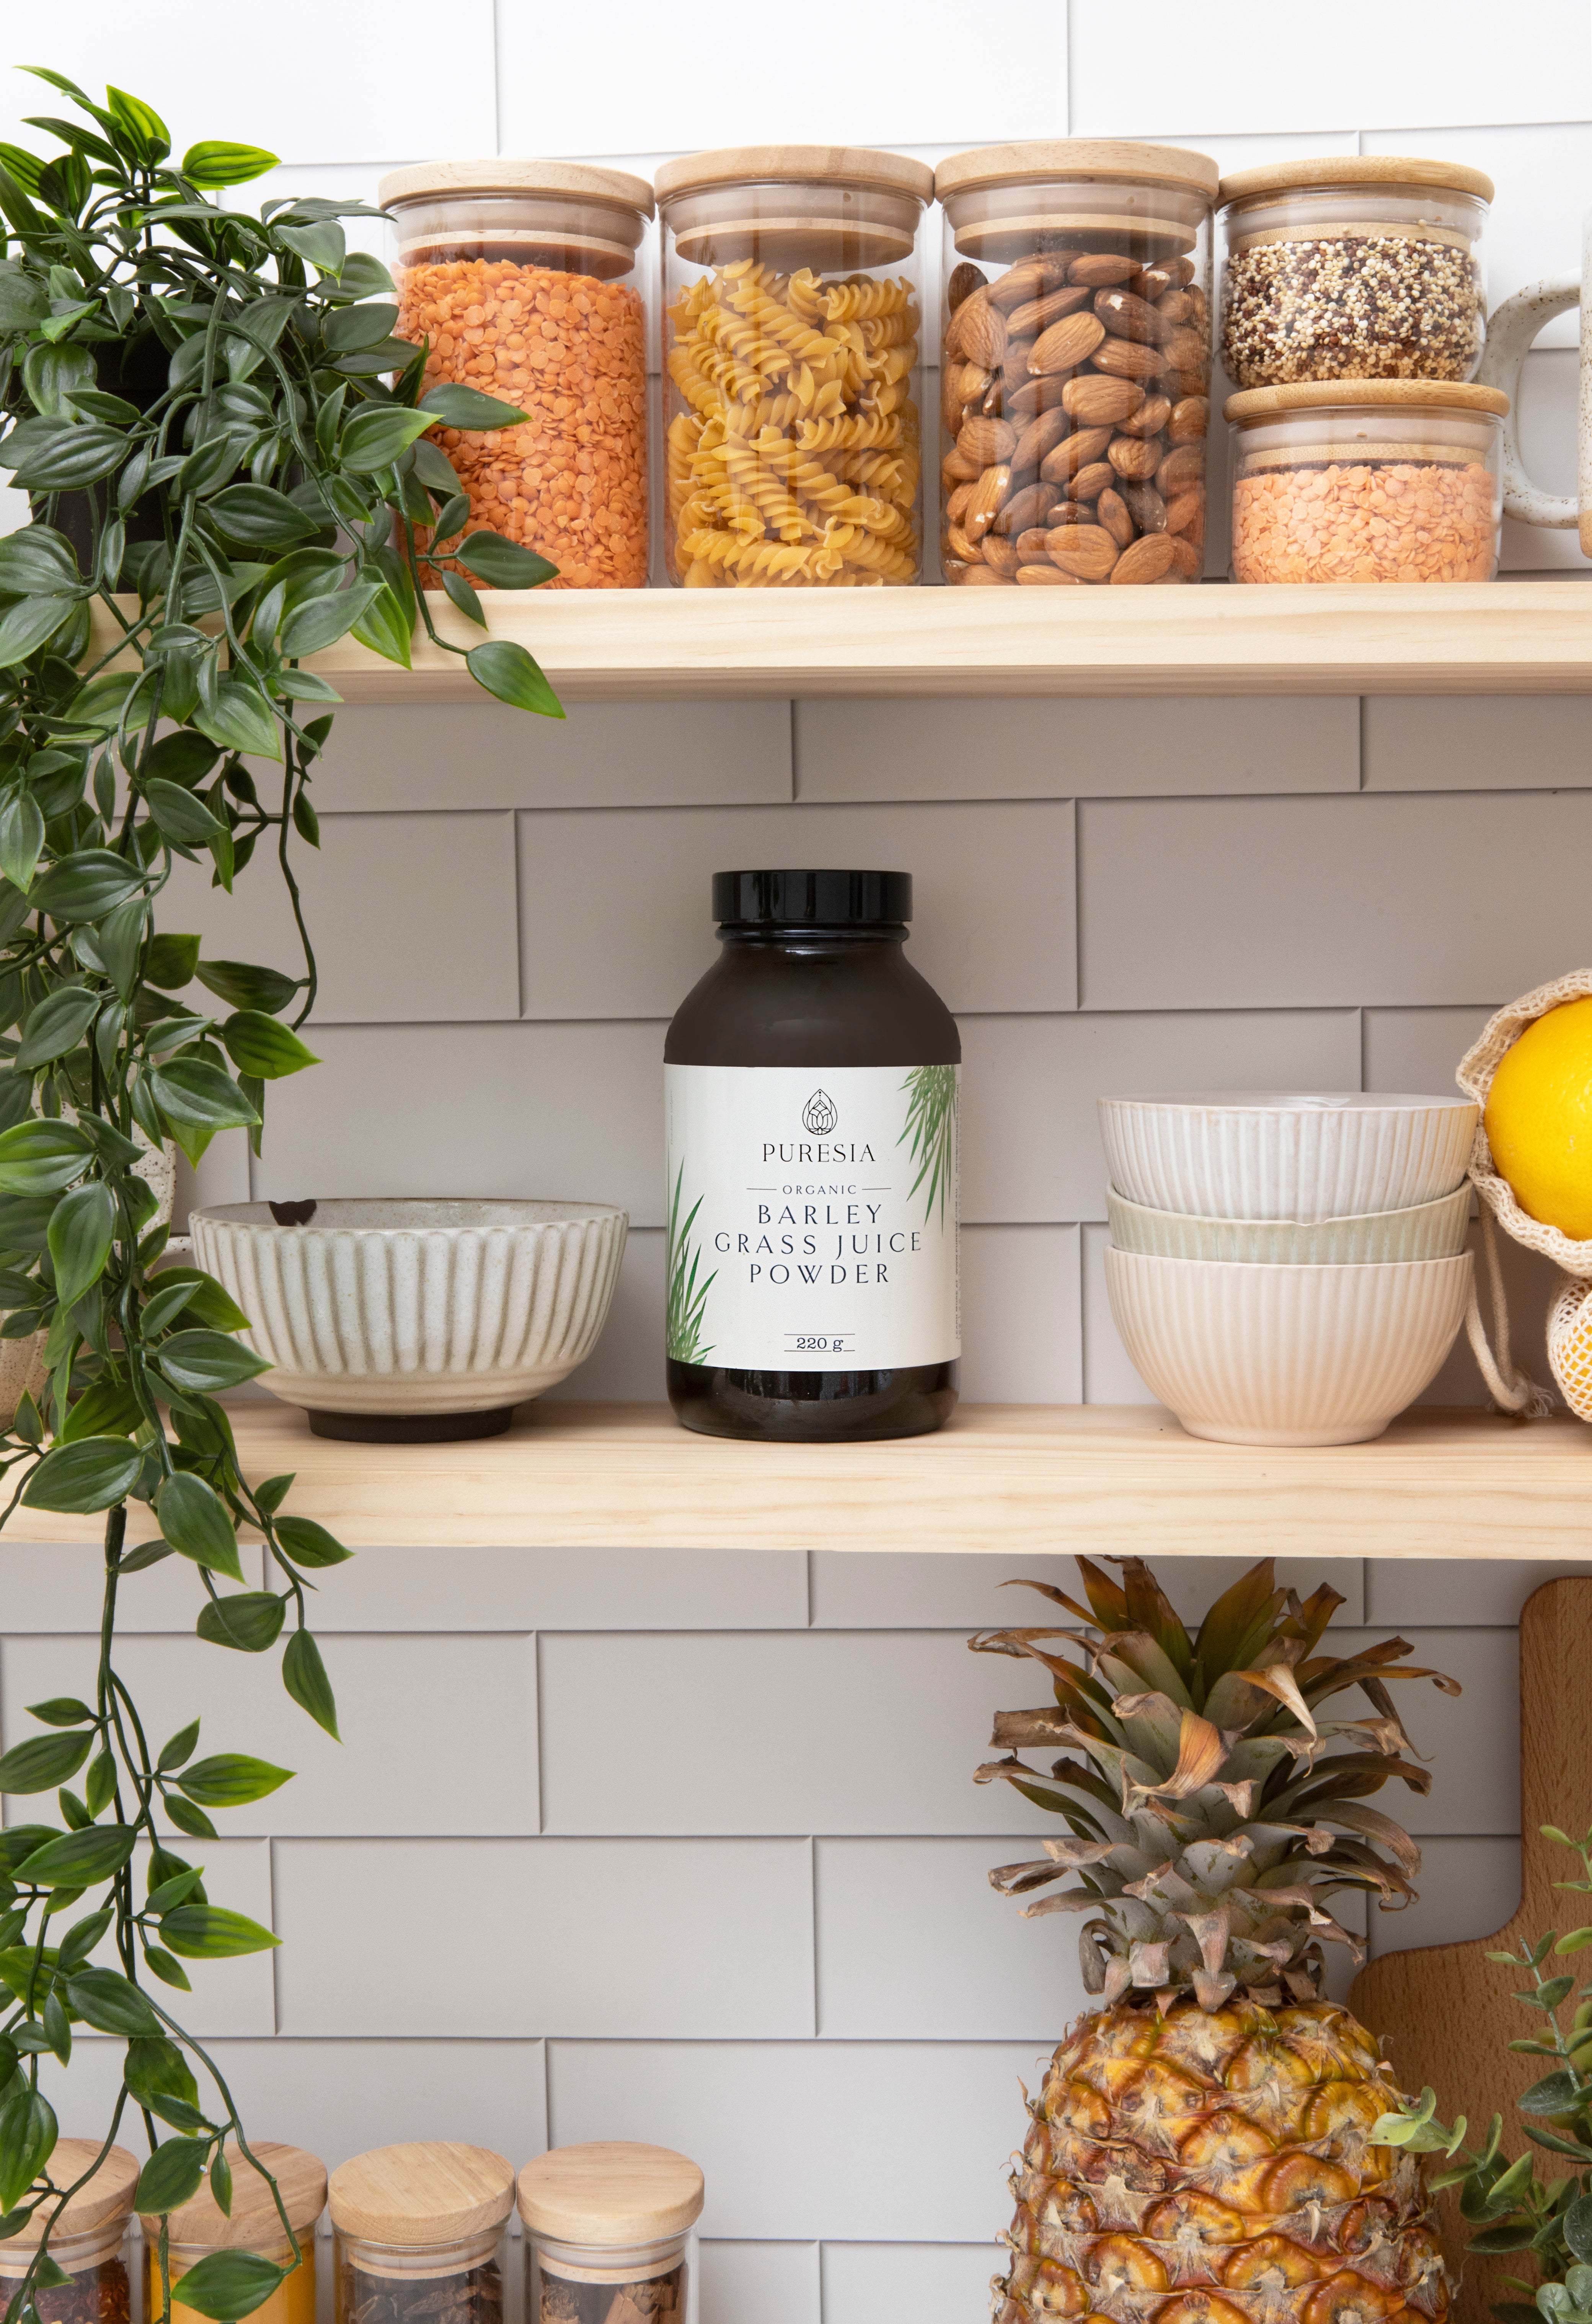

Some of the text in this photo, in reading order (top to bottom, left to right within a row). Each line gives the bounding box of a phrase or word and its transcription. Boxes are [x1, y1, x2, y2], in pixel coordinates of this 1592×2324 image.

[763, 1144, 876, 1162] PURESIA
[783, 1185, 856, 1195] ORGANIC
[758, 1204, 882, 1224] BARLEY
[715, 1232, 922, 1260] GRASS JUICE
[750, 1263, 889, 1284] POWDER
[797, 1338, 844, 1352] 220 g
